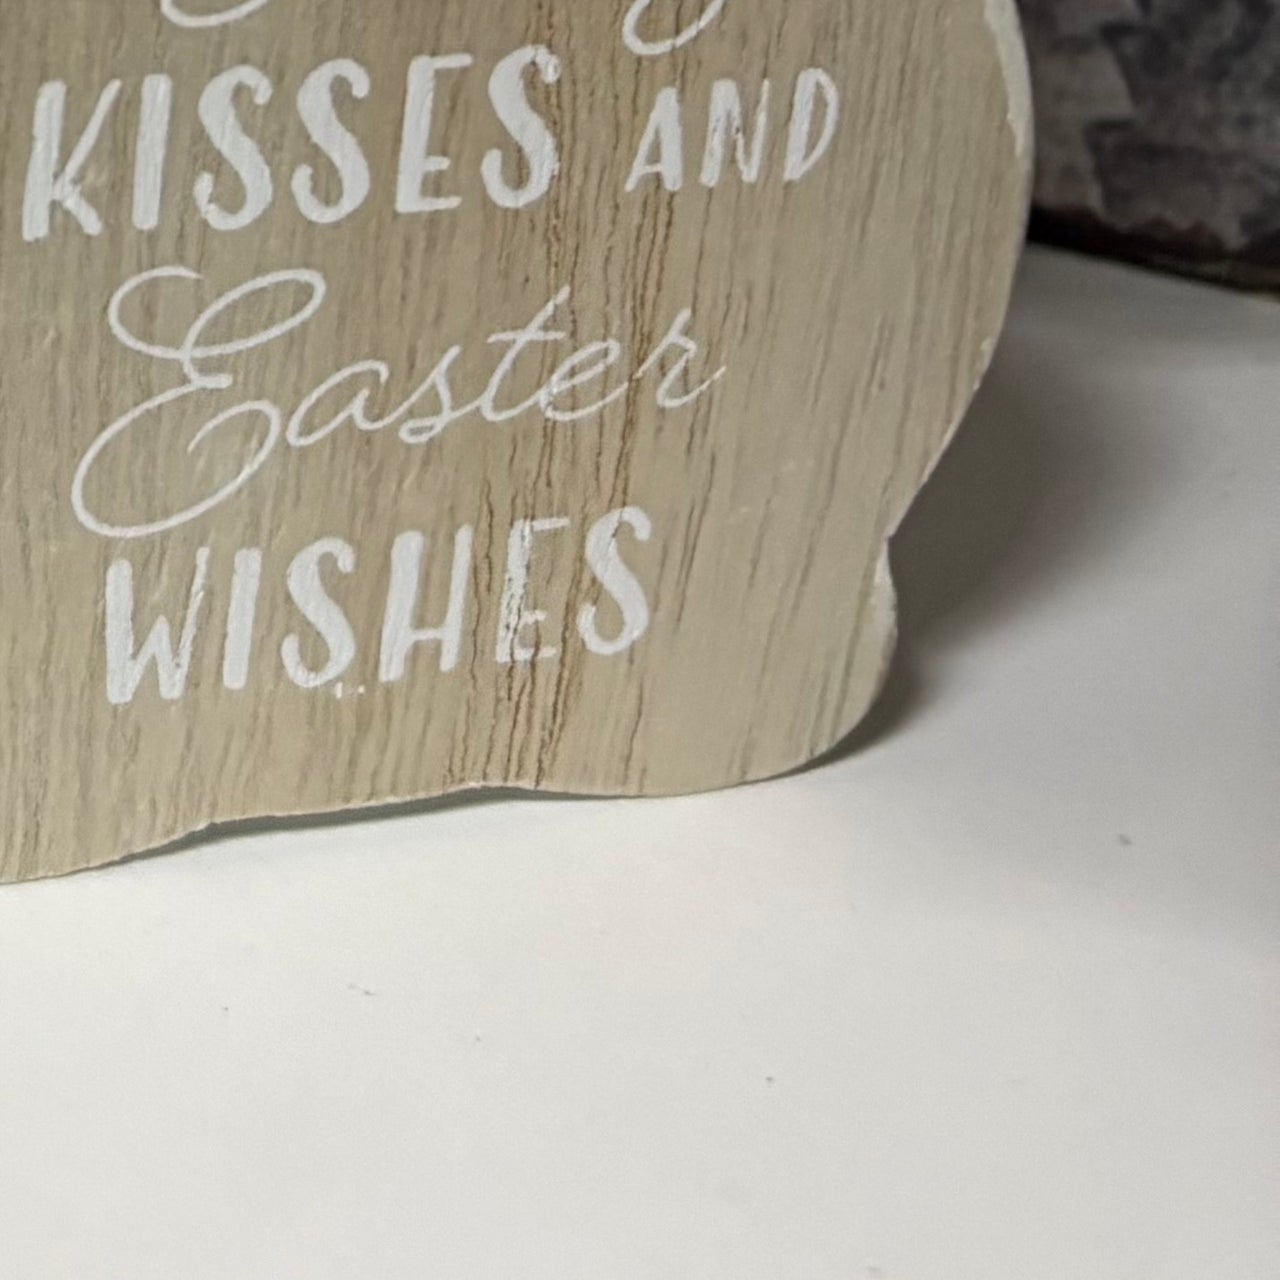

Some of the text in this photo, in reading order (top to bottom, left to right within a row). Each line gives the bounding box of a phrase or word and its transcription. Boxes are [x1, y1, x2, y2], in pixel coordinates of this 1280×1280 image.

[22, 44, 840, 241] KISSES AND
[71, 264, 726, 539] Easter
[105, 504, 652, 704] WISHES
